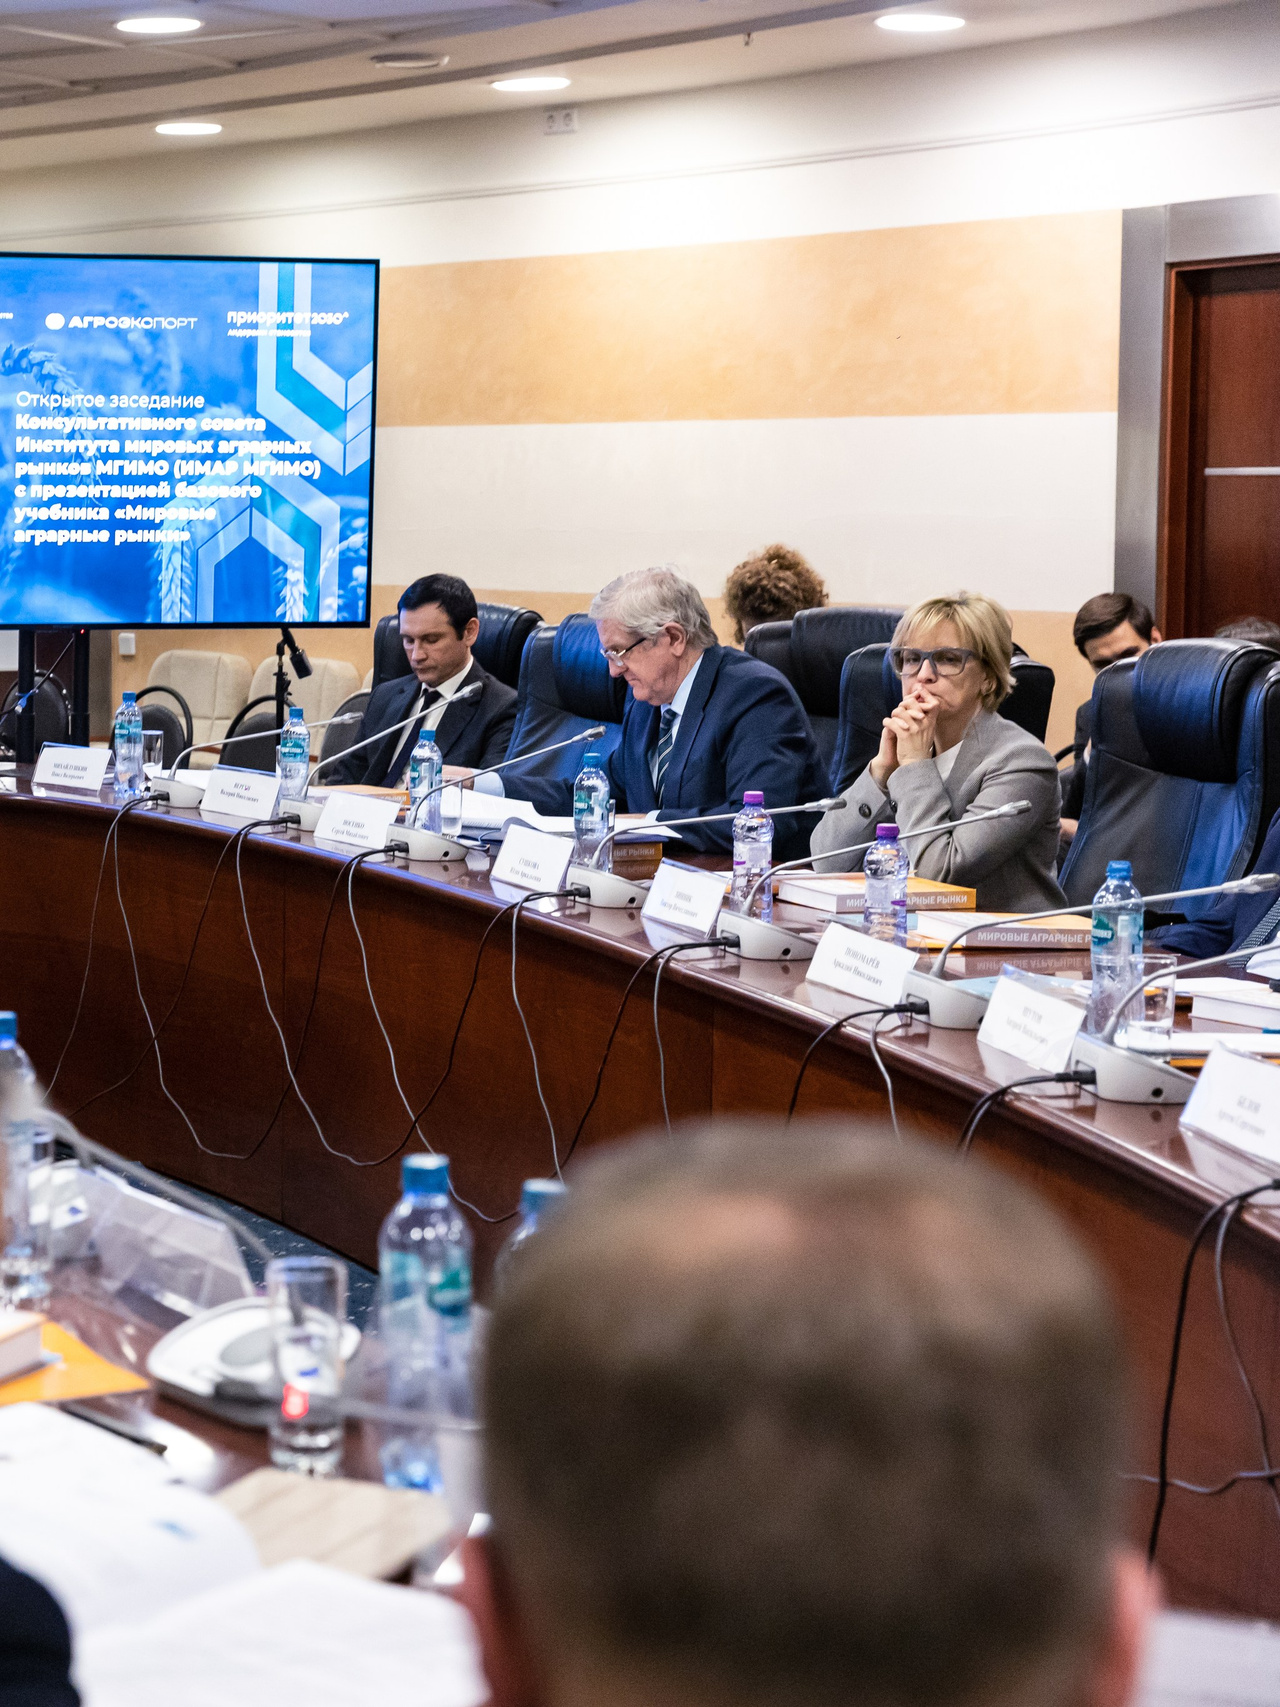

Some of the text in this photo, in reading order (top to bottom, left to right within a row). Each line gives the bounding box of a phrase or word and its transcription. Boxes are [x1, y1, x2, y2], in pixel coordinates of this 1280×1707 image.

[16, 391, 205, 410] Открытое заседание
[15, 413, 266, 433] Консультативного совета
[15, 436, 312, 457] Института мировых аграрных
[14, 459, 321, 479] рынков МГИМО (ИМАР МГИМО)
[14, 481, 262, 501] с презентацией базового
[13, 504, 216, 523] учебника «Мировые
[13, 529, 191, 546] аграрные рынки»
[906, 895, 968, 905] АРНЫЕ РЫНКИ
[977, 931, 1029, 942] МИРОВЫЕ
[1031, 933, 1082, 943] АГРАРНЫЕ
